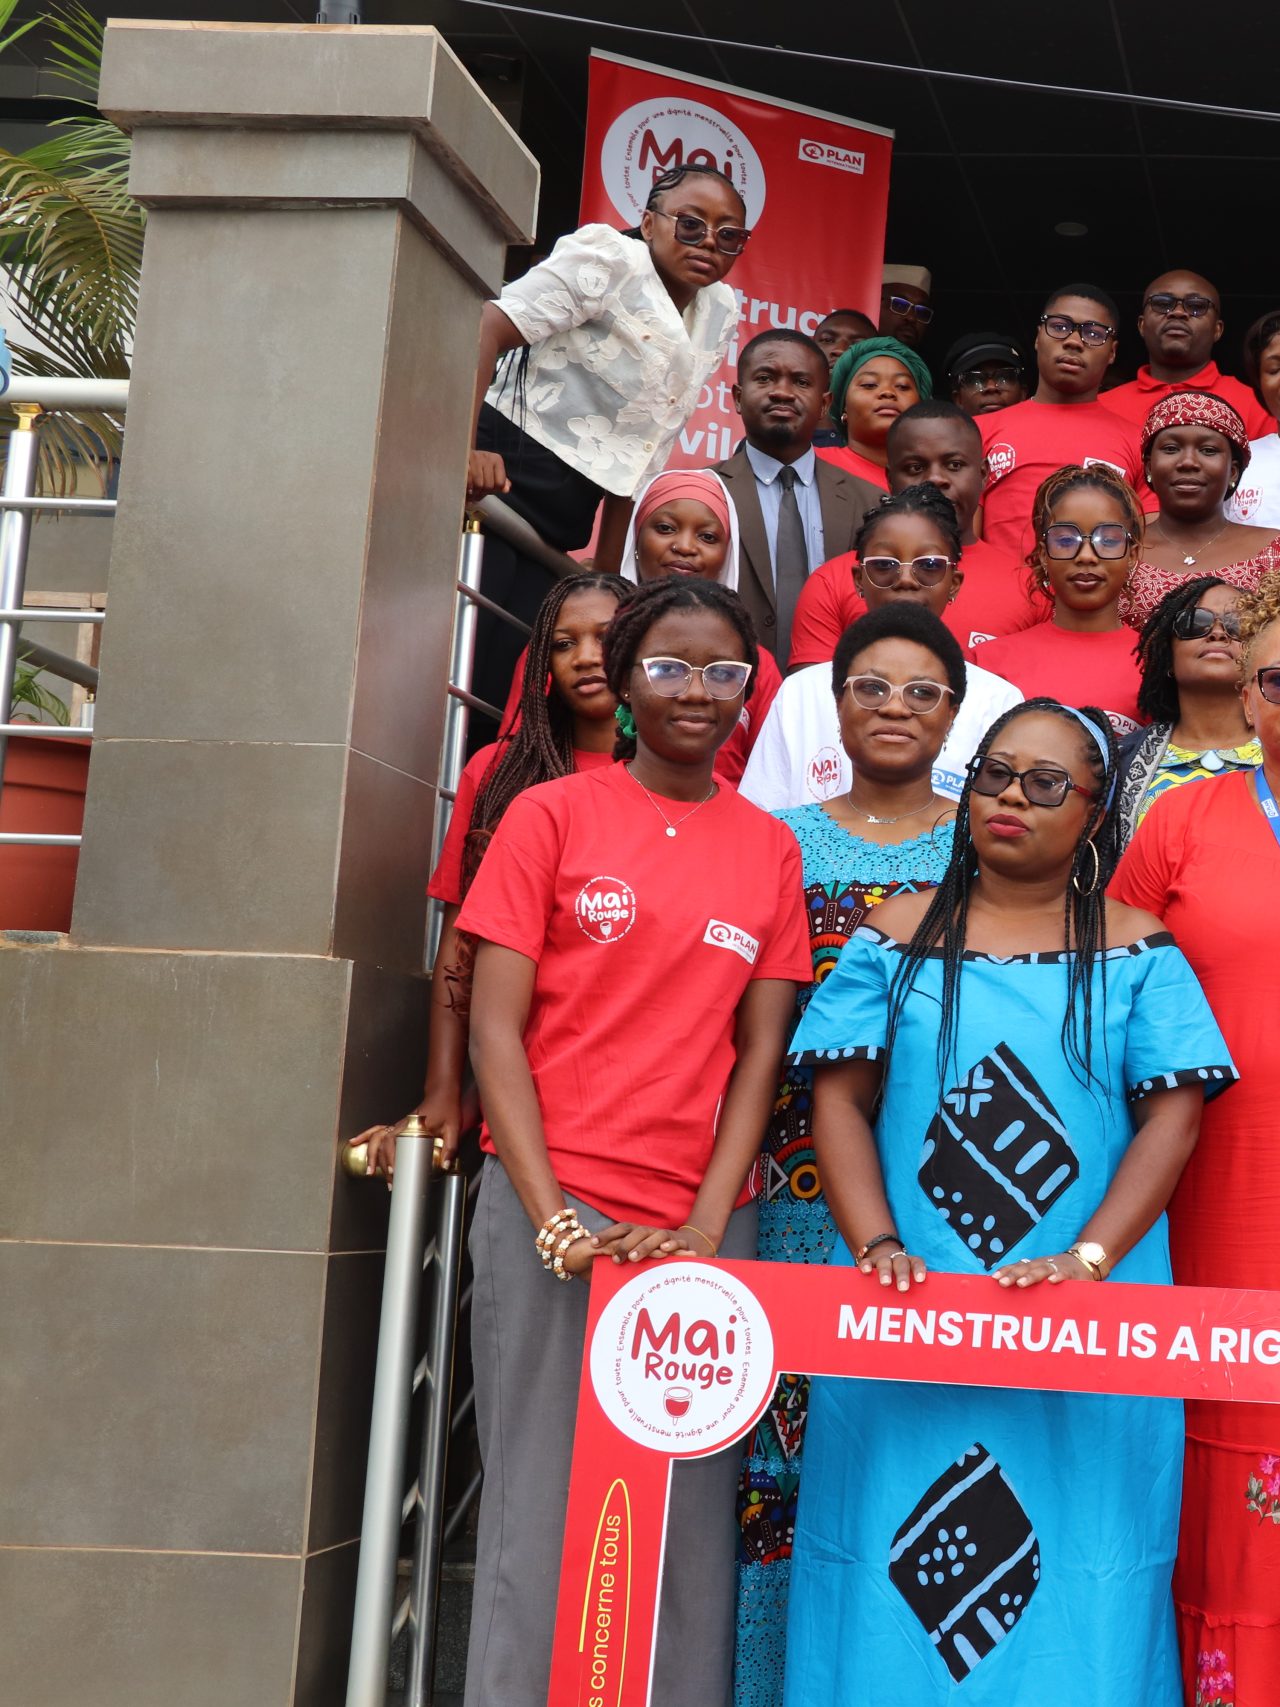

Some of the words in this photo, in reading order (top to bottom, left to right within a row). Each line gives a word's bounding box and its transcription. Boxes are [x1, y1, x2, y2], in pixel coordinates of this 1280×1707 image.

[826, 149, 862, 167] PLAN
[946, 774, 965, 789] PLA
[581, 888, 628, 916] Mai
[588, 909, 629, 922] Rouge
[734, 932, 757, 955] PLAN
[648, 1282, 661, 1294] une
[664, 1275, 691, 1286] dignité
[695, 1277, 738, 1305] menstruelle
[631, 1293, 645, 1310] pour
[736, 1306, 749, 1324] pour
[617, 1311, 632, 1351] Ensemble
[631, 1307, 737, 1360] Mai
[744, 1327, 752, 1355] toutes
[837, 1304, 1107, 1356] MENSTRUAL
[1117, 1322, 1158, 1359] IS
[1166, 1325, 1200, 1362] A
[614, 1358, 622, 1386] toutes
[644, 1352, 734, 1390] Rouge
[736, 1361, 750, 1402] Ensemble
[618, 1390, 630, 1407] pour
[628, 1408, 672, 1437] menstruelle
[722, 1403, 736, 1421] pour
[675, 1428, 703, 1439] dignité
[705, 1420, 719, 1431] une
[600, 1514, 621, 1567] tous
[590, 1573, 615, 1690] concerne
